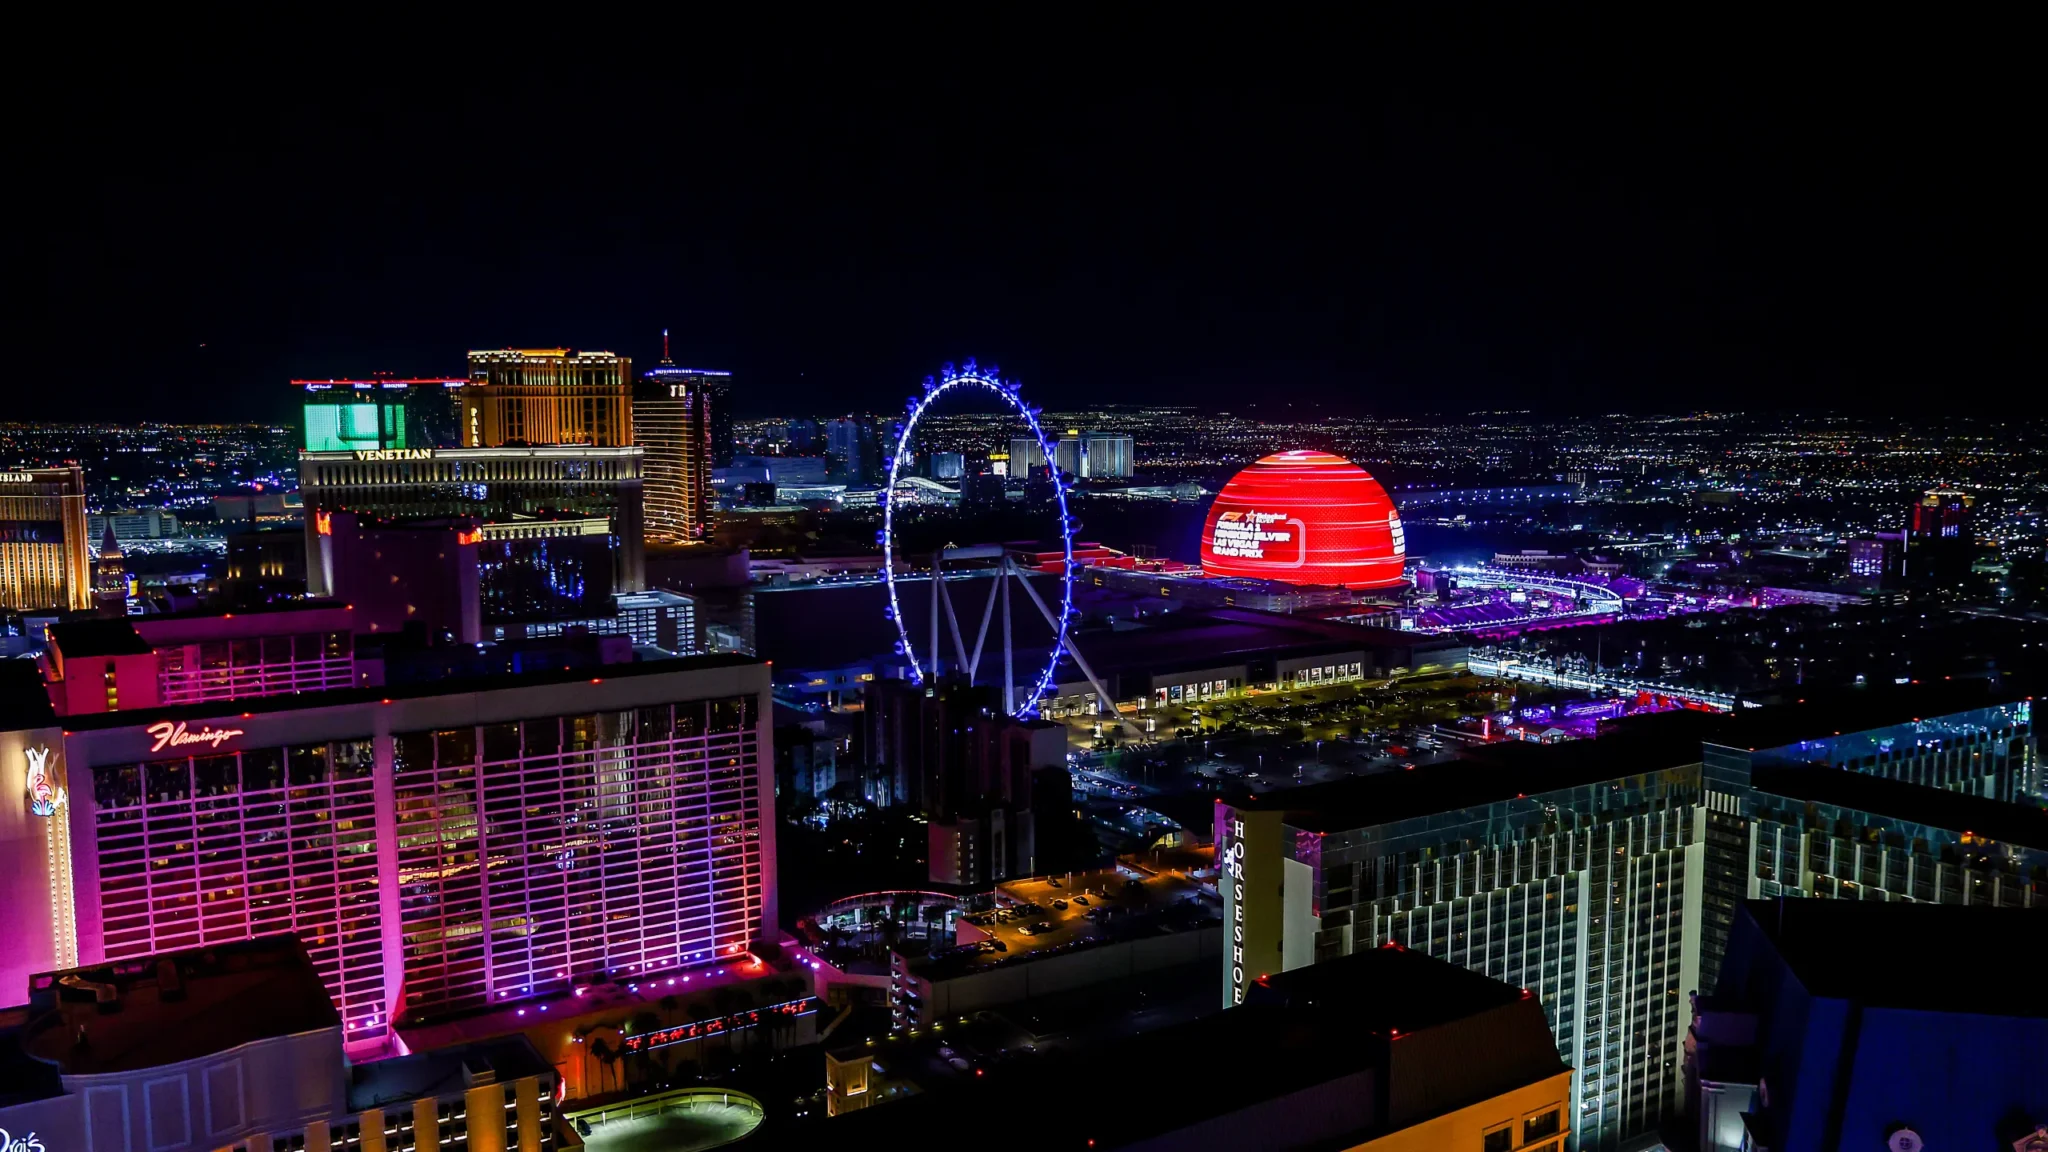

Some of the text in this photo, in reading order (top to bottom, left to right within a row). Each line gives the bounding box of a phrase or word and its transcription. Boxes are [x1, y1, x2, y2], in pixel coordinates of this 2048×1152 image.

[356, 449, 432, 461] VENETIAN
[0, 473, 33, 482] ISLAND
[1254, 532, 1291, 541] SILVER
[1213, 538, 1260, 549] LAS VEGAS
[1212, 546, 1263, 558] GRAND PRIX
[147, 721, 244, 752] Flamingo
[1233, 820, 1245, 1005] HORSESHOE
